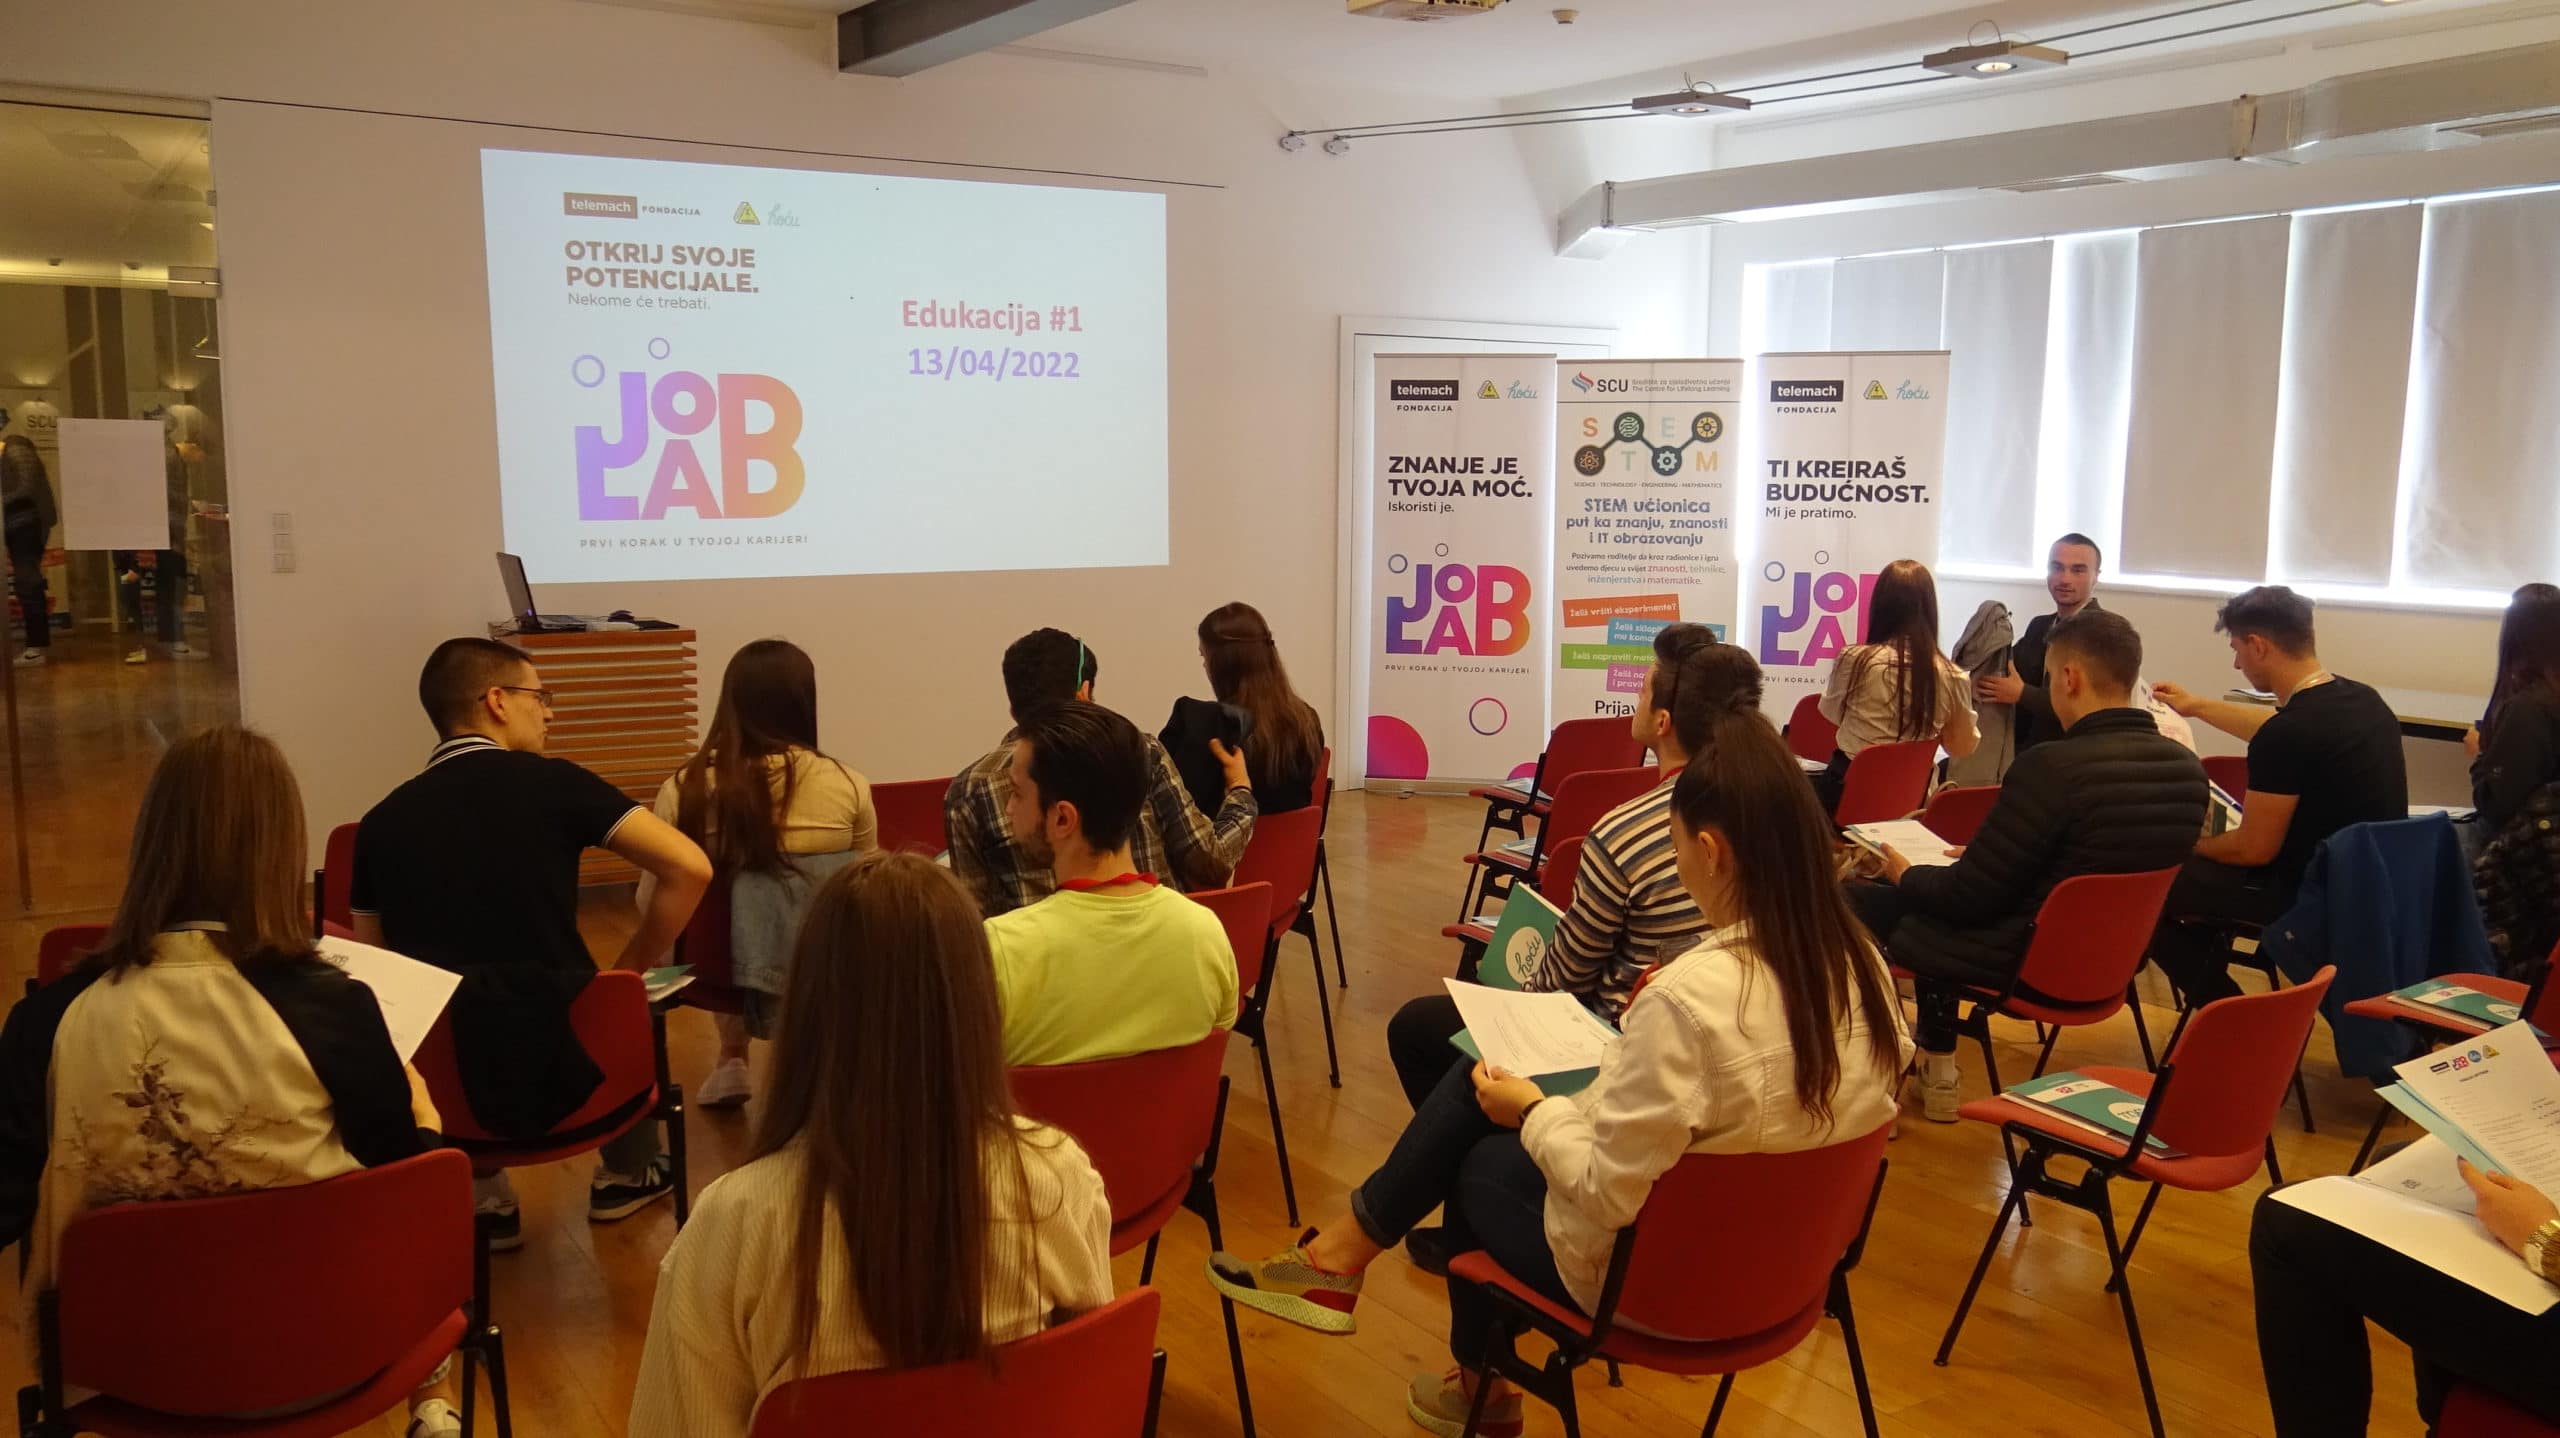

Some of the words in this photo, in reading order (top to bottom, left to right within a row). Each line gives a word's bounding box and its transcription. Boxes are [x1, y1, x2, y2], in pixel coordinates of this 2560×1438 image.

[571, 199, 632, 214] telemach
[641, 205, 701, 216] FONDACIJA
[564, 240, 664, 265] OTKRIJ
[671, 244, 756, 268] SVOJE
[566, 265, 760, 293] POTENCIJALE.
[567, 292, 632, 308] Nekome
[636, 293, 654, 309] će
[657, 296, 712, 310] trebati.
[902, 299, 1041, 337] Edukacija
[1049, 305, 1084, 332] #1
[908, 346, 1081, 382] 13/04/2022
[1397, 384, 1453, 396] telemach
[1597, 378, 1629, 393] SCU
[1777, 385, 1837, 397] telemach
[1396, 404, 1453, 412] FONDACIJA
[1776, 406, 1837, 414] FONDACIJA
[1583, 417, 1599, 437] S
[1661, 417, 1675, 438] E
[1388, 456, 1485, 474] ZNANJE
[1490, 457, 1518, 475] JE
[1621, 450, 1637, 471] T
[1695, 451, 1719, 472] M
[1767, 460, 1789, 478] TI
[1796, 455, 1906, 479] KREIRAŠ
[1387, 479, 1466, 497] TVOJA
[1472, 475, 1533, 498] MOĆ.
[1766, 479, 1930, 503] BUDUĆNOST.
[1388, 501, 1437, 512] Iskoristi
[1440, 501, 1455, 514] je.
[1584, 498, 1628, 513] STEM
[1765, 506, 1781, 518] Mi
[1783, 506, 1797, 520] je
[1800, 507, 1857, 520] pratimo.
[1566, 516, 1590, 530] put
[1594, 517, 1611, 529] ka
[1615, 516, 1665, 531] znanju,
[1669, 517, 1729, 530] znanosti
[579, 538, 613, 549] PRVI
[619, 537, 667, 548] KORAK
[673, 537, 683, 547] U
[689, 536, 740, 547] TVOJOJ
[746, 535, 809, 546] KARIJERI
[1589, 533, 1594, 544] i
[1597, 532, 1609, 544] IT
[1613, 532, 1704, 548] obrazovanju
[1571, 552, 1606, 561] Pozivamo
[1607, 552, 1637, 562] roditelje
[1638, 553, 1647, 561] da
[1648, 553, 1664, 561] kroz
[1665, 553, 1699, 562] radionice
[1704, 554, 1719, 563] igru
[1600, 564, 1620, 574] djecu
[1587, 574, 1642, 585] inženjerstva
[1647, 575, 1703, 585] matematike.
[1614, 602, 1677, 615] eksperimente?
[1409, 664, 1438, 672] KORAK
[1452, 665, 1485, 673] TVOJOJ
